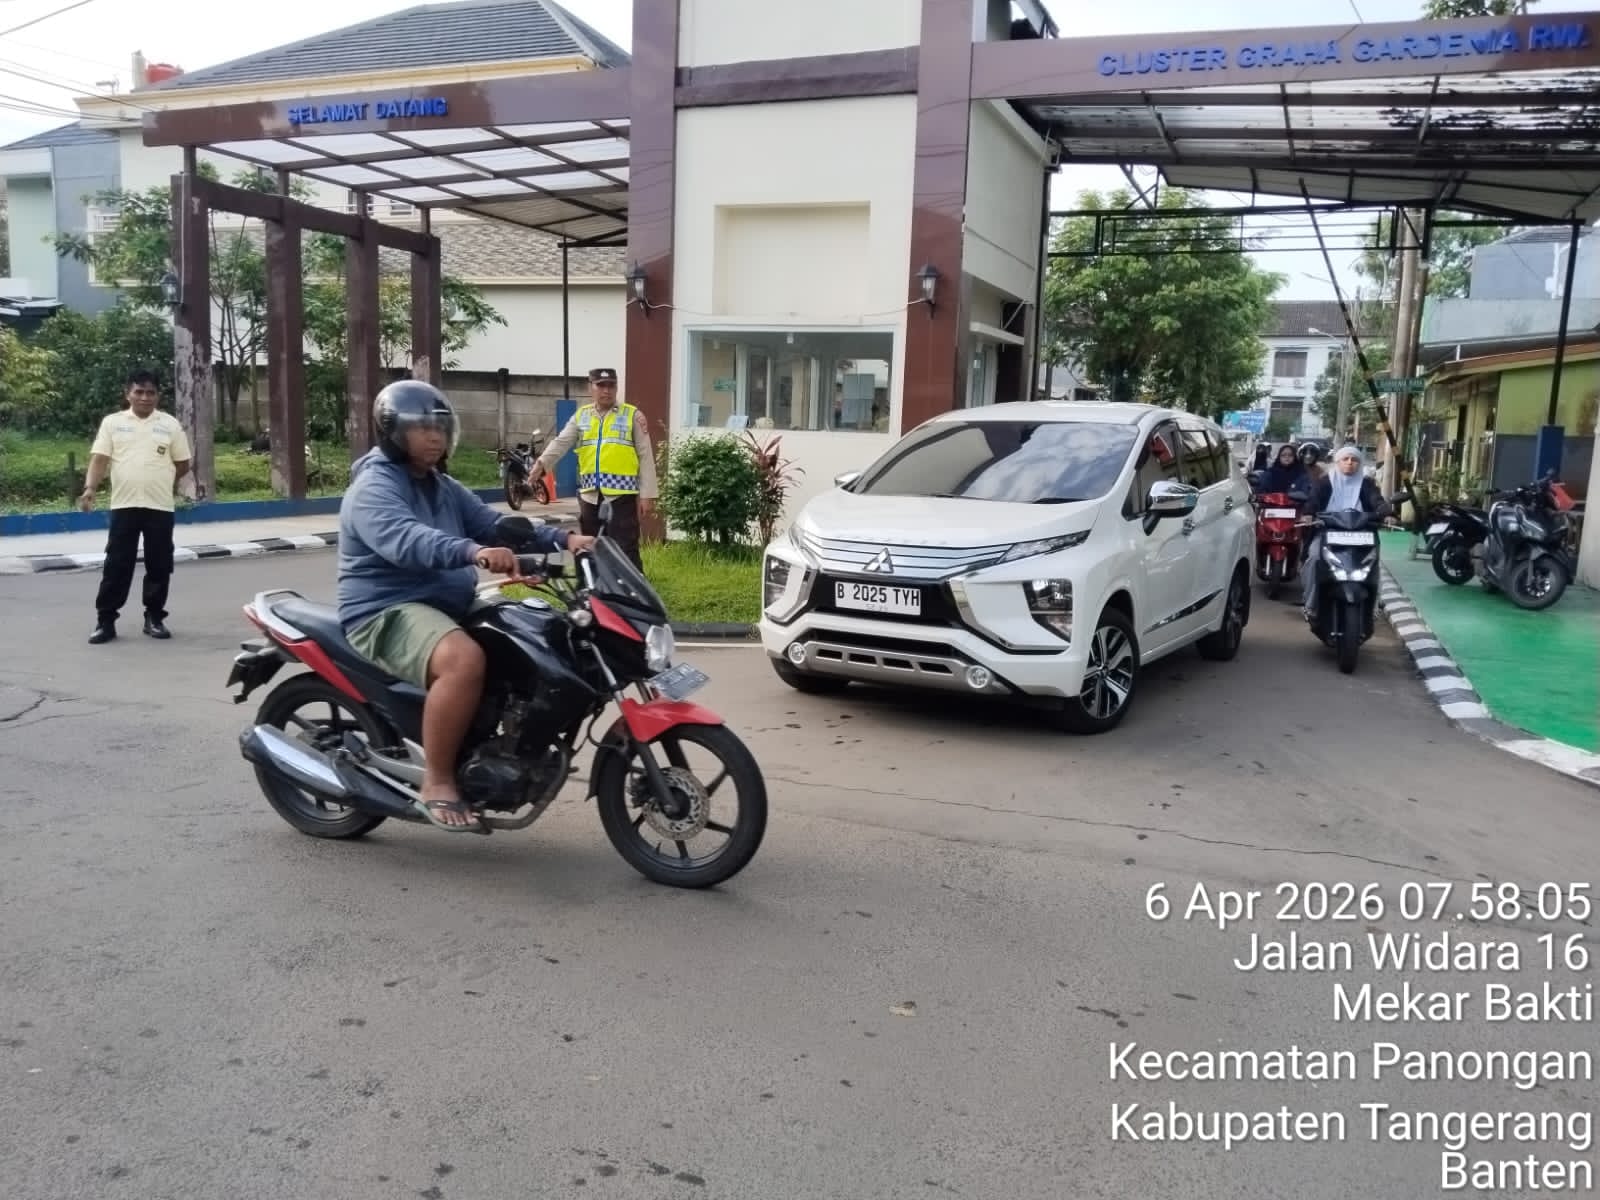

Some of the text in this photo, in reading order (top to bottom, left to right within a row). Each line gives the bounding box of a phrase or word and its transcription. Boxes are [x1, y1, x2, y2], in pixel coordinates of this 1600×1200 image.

[1099, 47, 1228, 76] CLUSTER
[1237, 40, 1342, 69] GRAHA
[288, 97, 448, 125] SELAMAT DATANG
[837, 583, 845, 599] B
[853, 584, 887, 603] 2025
[893, 588, 920, 607] TYH
